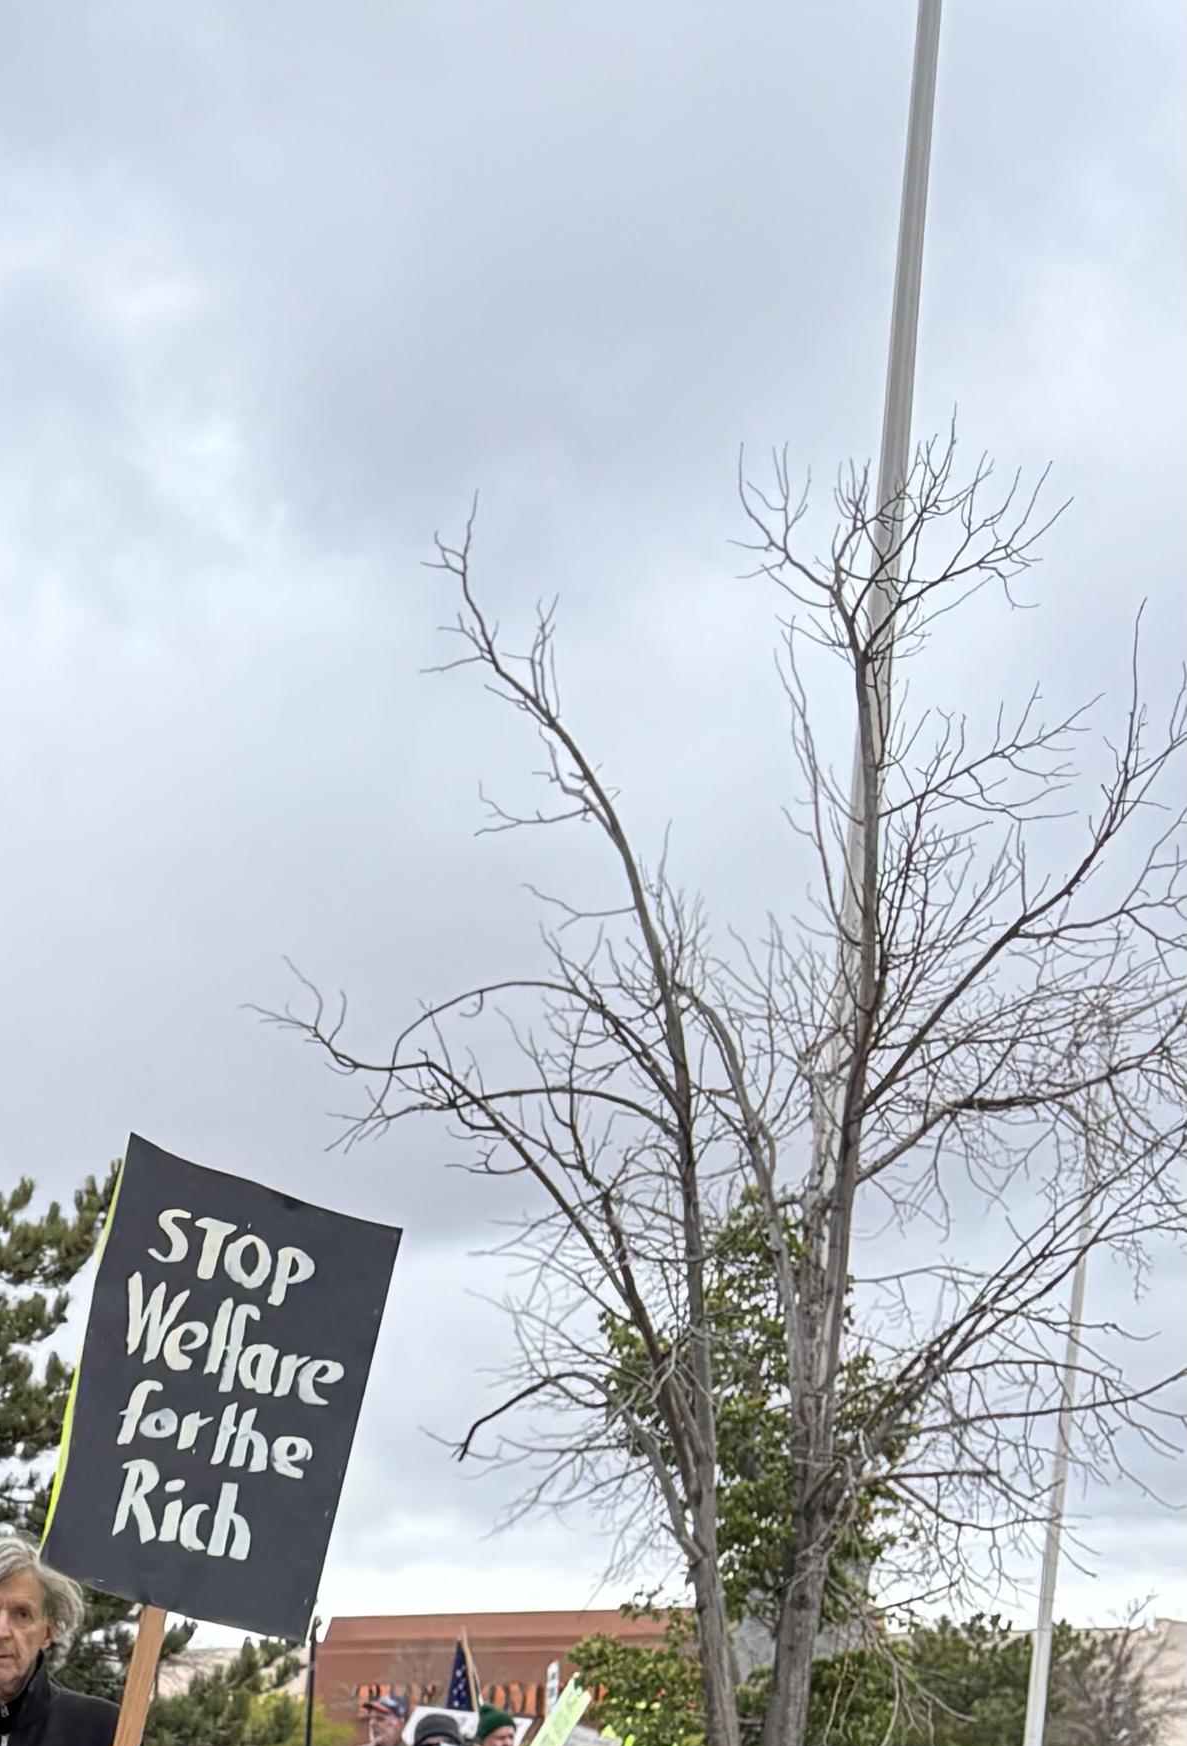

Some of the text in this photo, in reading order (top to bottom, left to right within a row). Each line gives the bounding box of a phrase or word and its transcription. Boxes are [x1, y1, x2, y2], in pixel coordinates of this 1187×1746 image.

[147, 1208, 316, 1306] STOP
[126, 1270, 345, 1406] Welfare
[116, 1379, 313, 1480] for the
[111, 1458, 252, 1561] Rich
